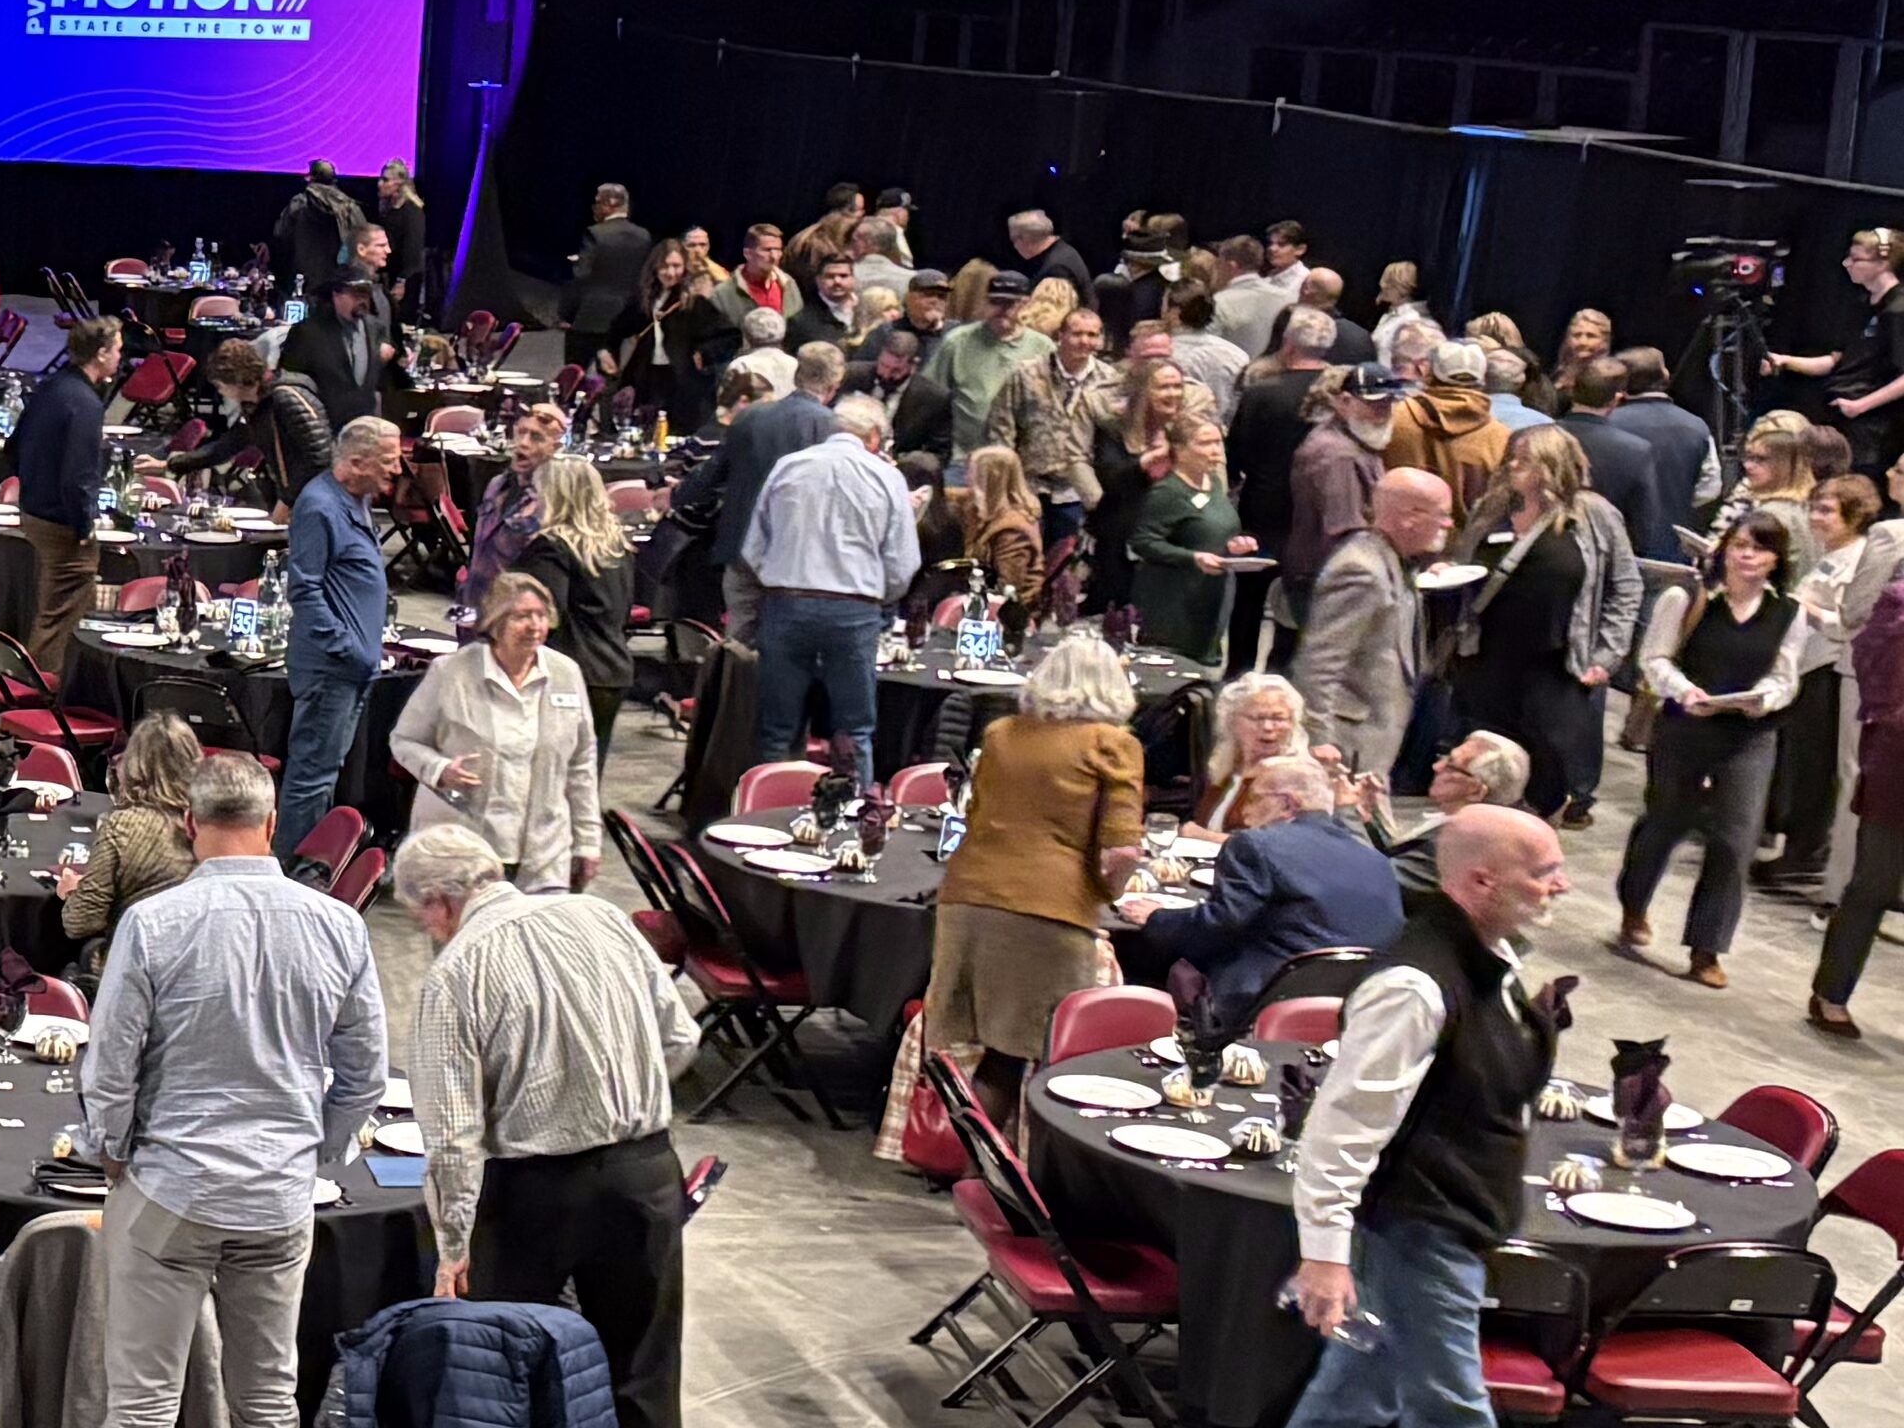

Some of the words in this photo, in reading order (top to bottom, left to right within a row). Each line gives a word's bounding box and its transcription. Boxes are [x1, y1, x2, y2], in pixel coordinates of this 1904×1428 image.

[59, 19, 123, 32] STATE
[141, 21, 165, 32] OF
[184, 22, 221, 34] THE
[240, 23, 301, 35] TOWN
[233, 613, 252, 634] 35
[960, 634, 988, 657] 36
